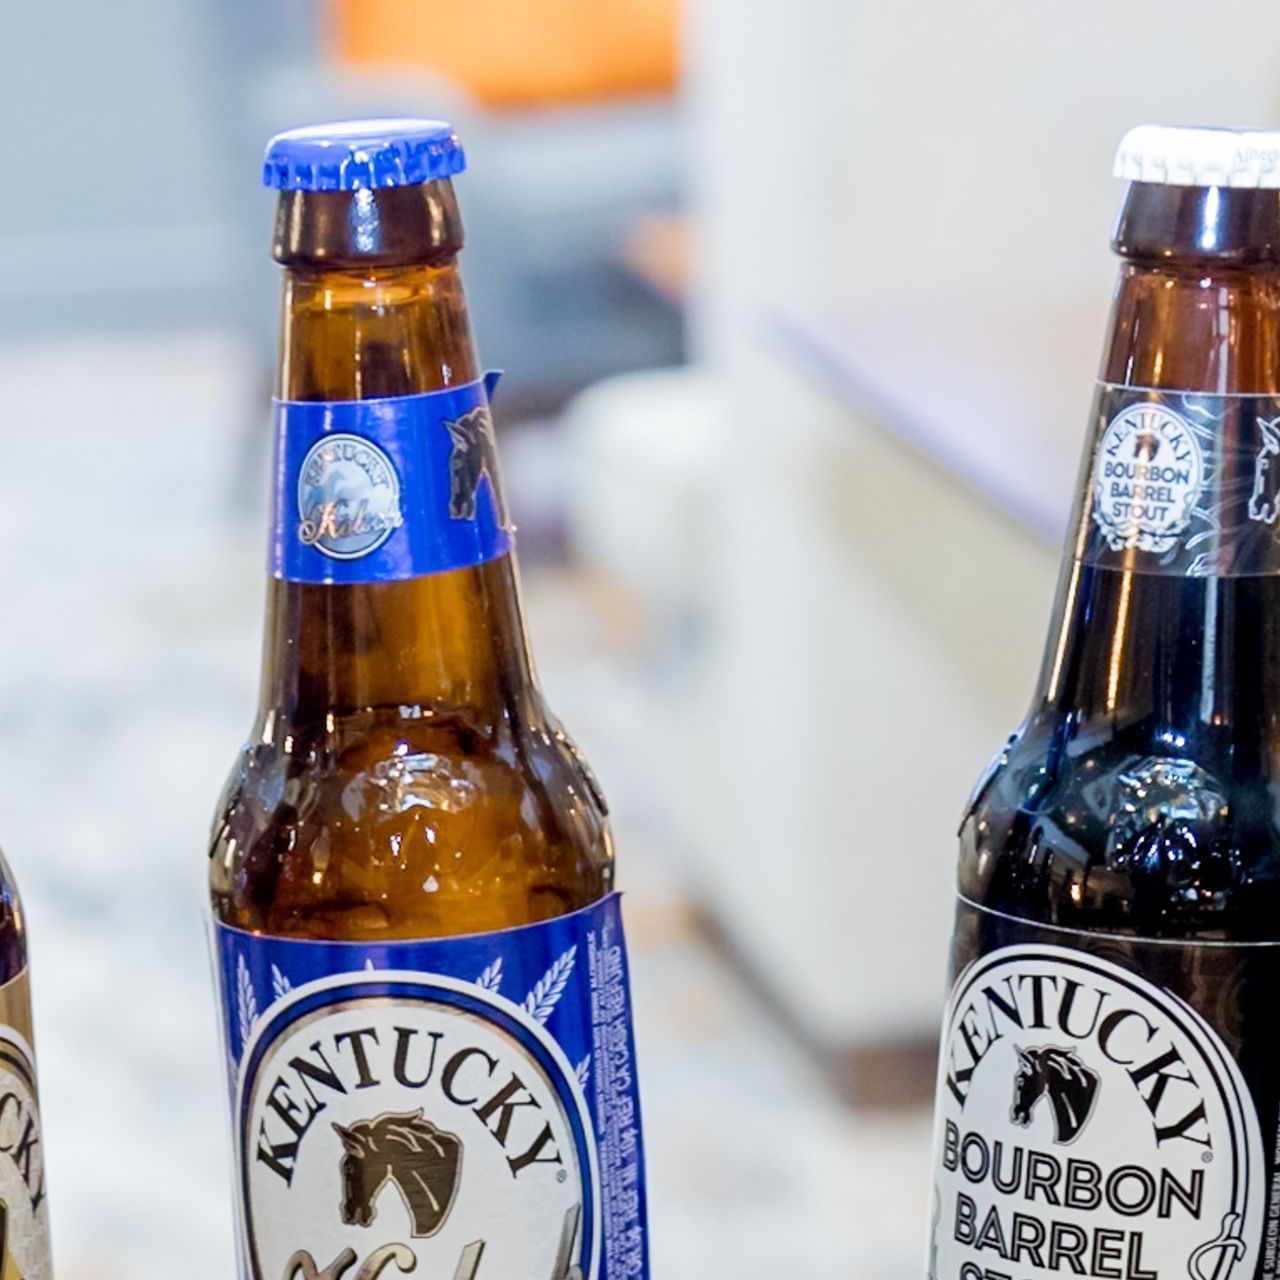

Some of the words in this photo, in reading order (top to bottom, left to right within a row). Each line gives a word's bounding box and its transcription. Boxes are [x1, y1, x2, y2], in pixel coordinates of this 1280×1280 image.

[1107, 412, 1193, 470] KENTUCKY
[1104, 461, 1190, 485] BOURBON
[1110, 481, 1175, 504] BARREL
[1113, 502, 1169, 522] STOUT
[945, 973, 1215, 1152] KENTUCKY
[256, 1025, 562, 1189] KENTUCKY
[941, 1118, 1206, 1222] BOURBON
[1264, 1220, 1279, 1269] SURGEON
